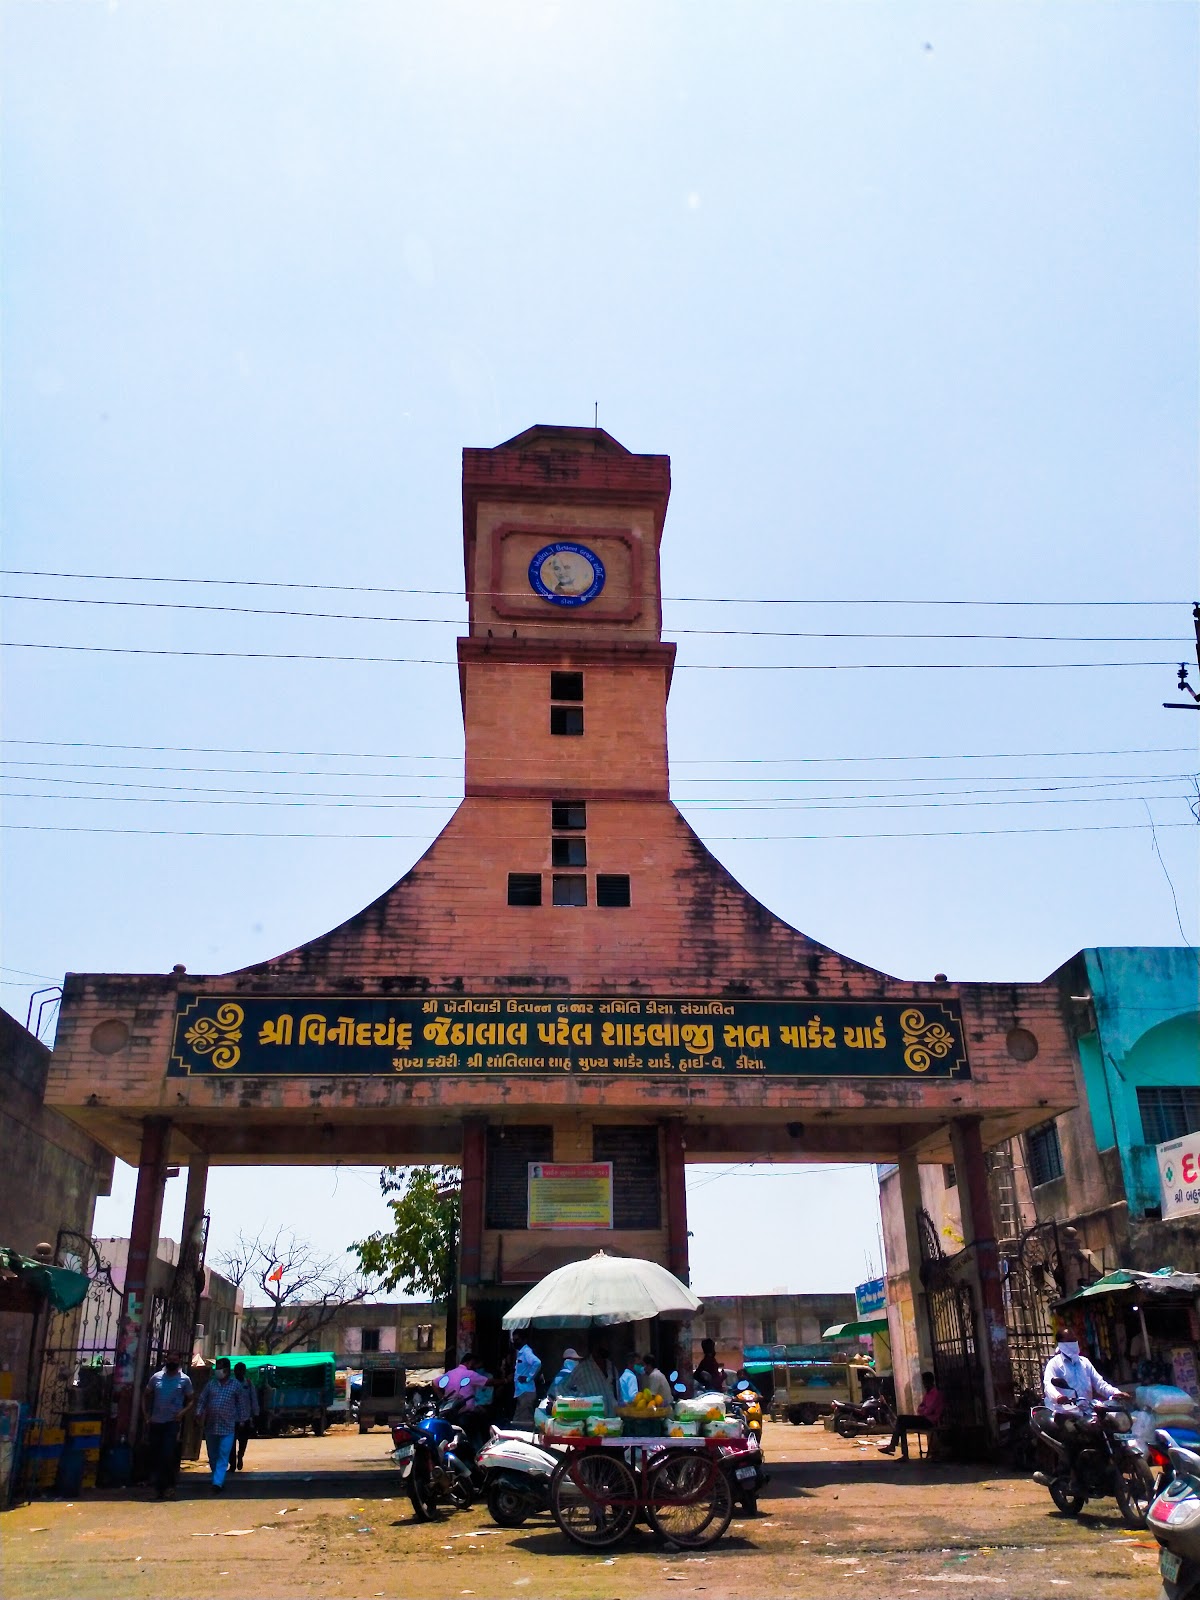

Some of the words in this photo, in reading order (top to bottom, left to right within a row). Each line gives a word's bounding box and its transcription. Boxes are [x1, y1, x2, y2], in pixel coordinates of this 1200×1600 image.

[421, 1000, 438, 1013] શ્રી
[443, 1000, 501, 1013] ખેતીવાડી
[506, 1000, 552, 1013] ઉત્પન્ન
[556, 1003, 594, 1014] બજાર
[599, 1001, 641, 1014] સમિતિ
[681, 1002, 735, 1015] સંચાલિત
[258, 1013, 294, 1046] શ્રી
[298, 1013, 413, 1050] વિનોદચંદ્ર
[422, 1016, 528, 1046] જેઠાલાલ
[537, 1016, 592, 1046] પટેલ
[601, 1022, 715, 1056] શાકભાજી
[723, 1024, 770, 1048] સબ
[779, 1015, 837, 1049] માર્કેટ
[843, 1015, 887, 1049] યાર્ડ
[391, 1057, 424, 1072] મુખ્ય
[466, 1052, 483, 1068] શ્રી
[486, 1052, 545, 1068] શાંતિલાલ
[548, 1057, 572, 1071] શાહ
[578, 1057, 609, 1072] મુખ્ય
[612, 1053, 643, 1068] માર્કેટ
[1174, 1188, 1184, 1203] શ્રી
